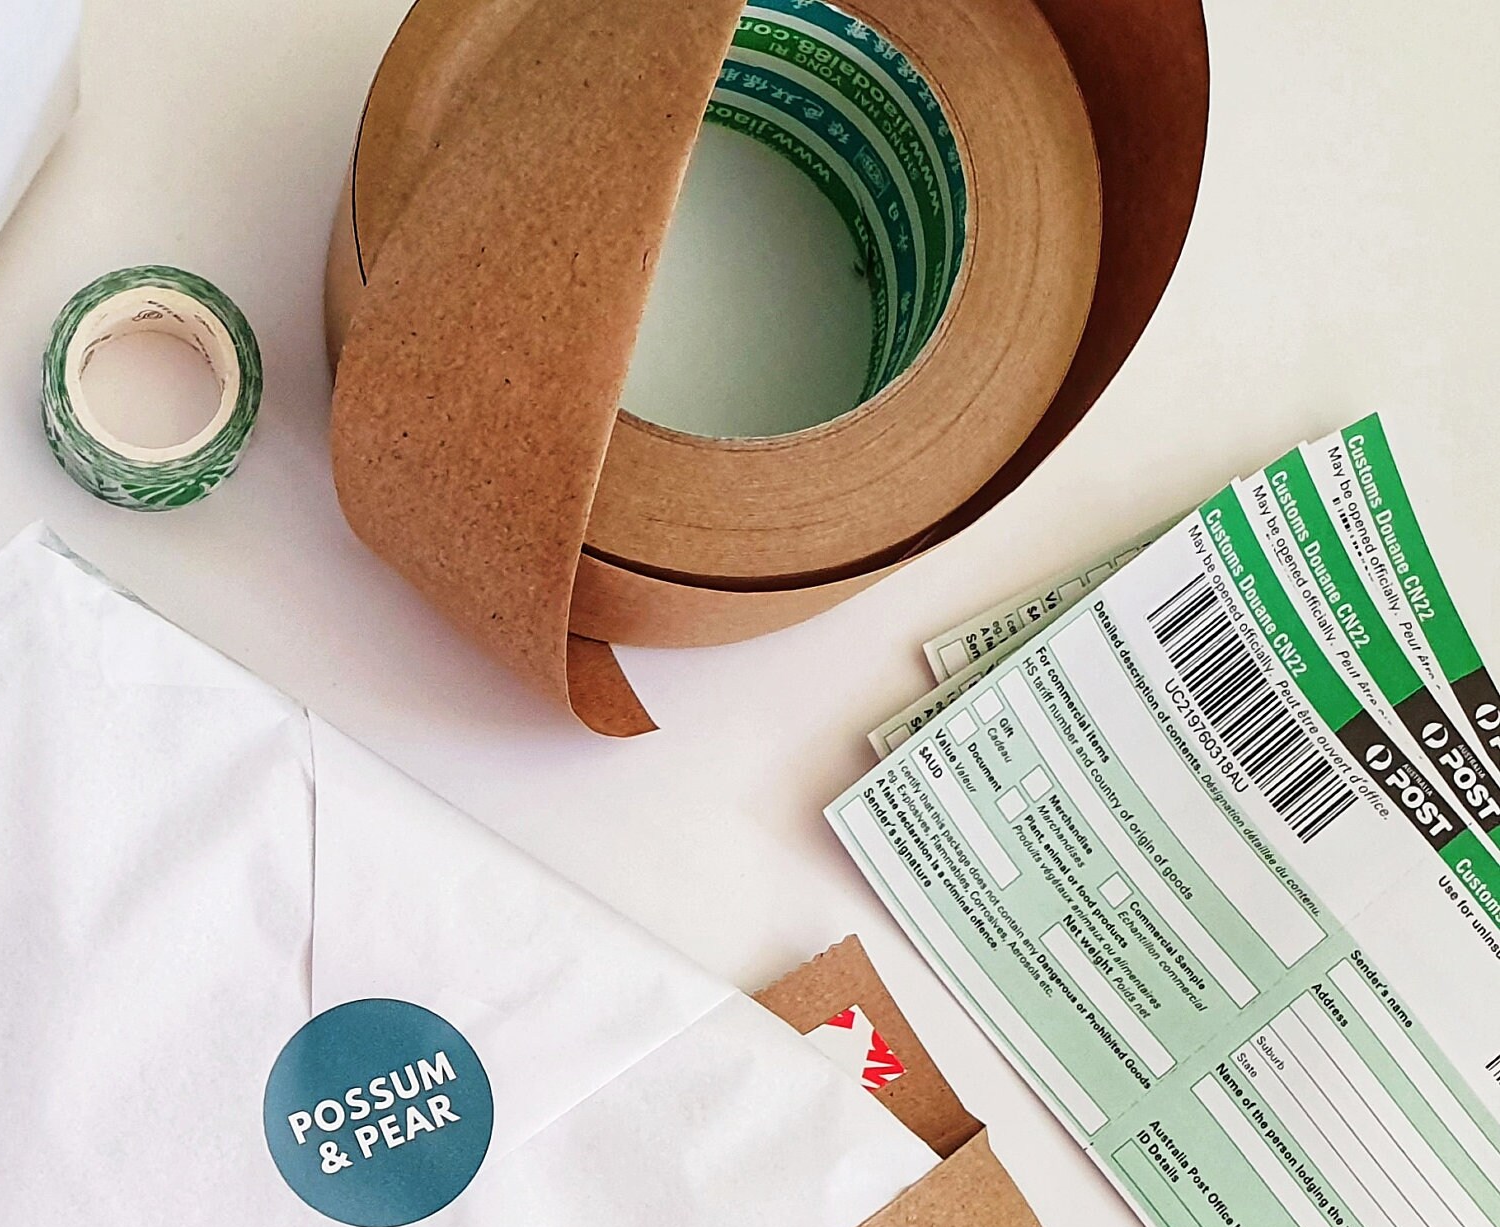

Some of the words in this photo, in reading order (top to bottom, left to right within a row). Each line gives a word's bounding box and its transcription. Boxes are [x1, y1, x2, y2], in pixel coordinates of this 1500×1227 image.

[795, 52, 843, 87] YONG
[1271, 470, 1309, 542] Customs
[1303, 540, 1341, 604] Douane
[1335, 602, 1370, 649] CN22
[1347, 434, 1382, 508] Customs
[1375, 508, 1409, 574] Douane
[1402, 574, 1435, 622] CN22
[1205, 508, 1244, 577] Customs
[1238, 573, 1276, 635] Douane
[1272, 632, 1307, 678] CN22
[1092, 599, 1125, 649] Detailed
[1118, 648, 1159, 710] description
[1156, 710, 1171, 724] of
[1165, 723, 1201, 777] contents.
[1187, 523, 1207, 555] May
[1201, 552, 1216, 574] be
[1211, 573, 1245, 622] opened
[1238, 622, 1274, 677] officially.
[1274, 679, 1301, 709] Peut
[1296, 709, 1319, 734] être
[1315, 735, 1352, 774] ouvert
[1034, 645, 1051, 667] For
[1046, 667, 1091, 731] commercial
[1085, 729, 1110, 763] items
[1164, 677, 1248, 793] UC219760318AU
[1021, 655, 1038, 677] HS
[1032, 674, 1055, 703] tariff
[1047, 702, 1079, 745] number
[1074, 745, 1095, 768] and
[1089, 767, 1122, 809] country
[1118, 808, 1135, 822] of
[1128, 822, 1155, 854] origin
[1152, 853, 1169, 867] of
[1161, 865, 1193, 900] goods
[1385, 768, 1451, 836] POST
[1439, 748, 1500, 818] POST
[1255, 1034, 1285, 1071] Suburb
[1310, 982, 1348, 1027] Address
[287, 1051, 457, 1145] POSSUM
[1235, 1051, 1257, 1078] State
[319, 1141, 354, 1174] &
[354, 1094, 461, 1159] PEAR
[1135, 1128, 1151, 1145] ID
[1147, 1142, 1179, 1183] Details
[1148, 1120, 1189, 1169] Australia
[1186, 1165, 1210, 1194] Post
[1206, 1191, 1234, 1226] Office
